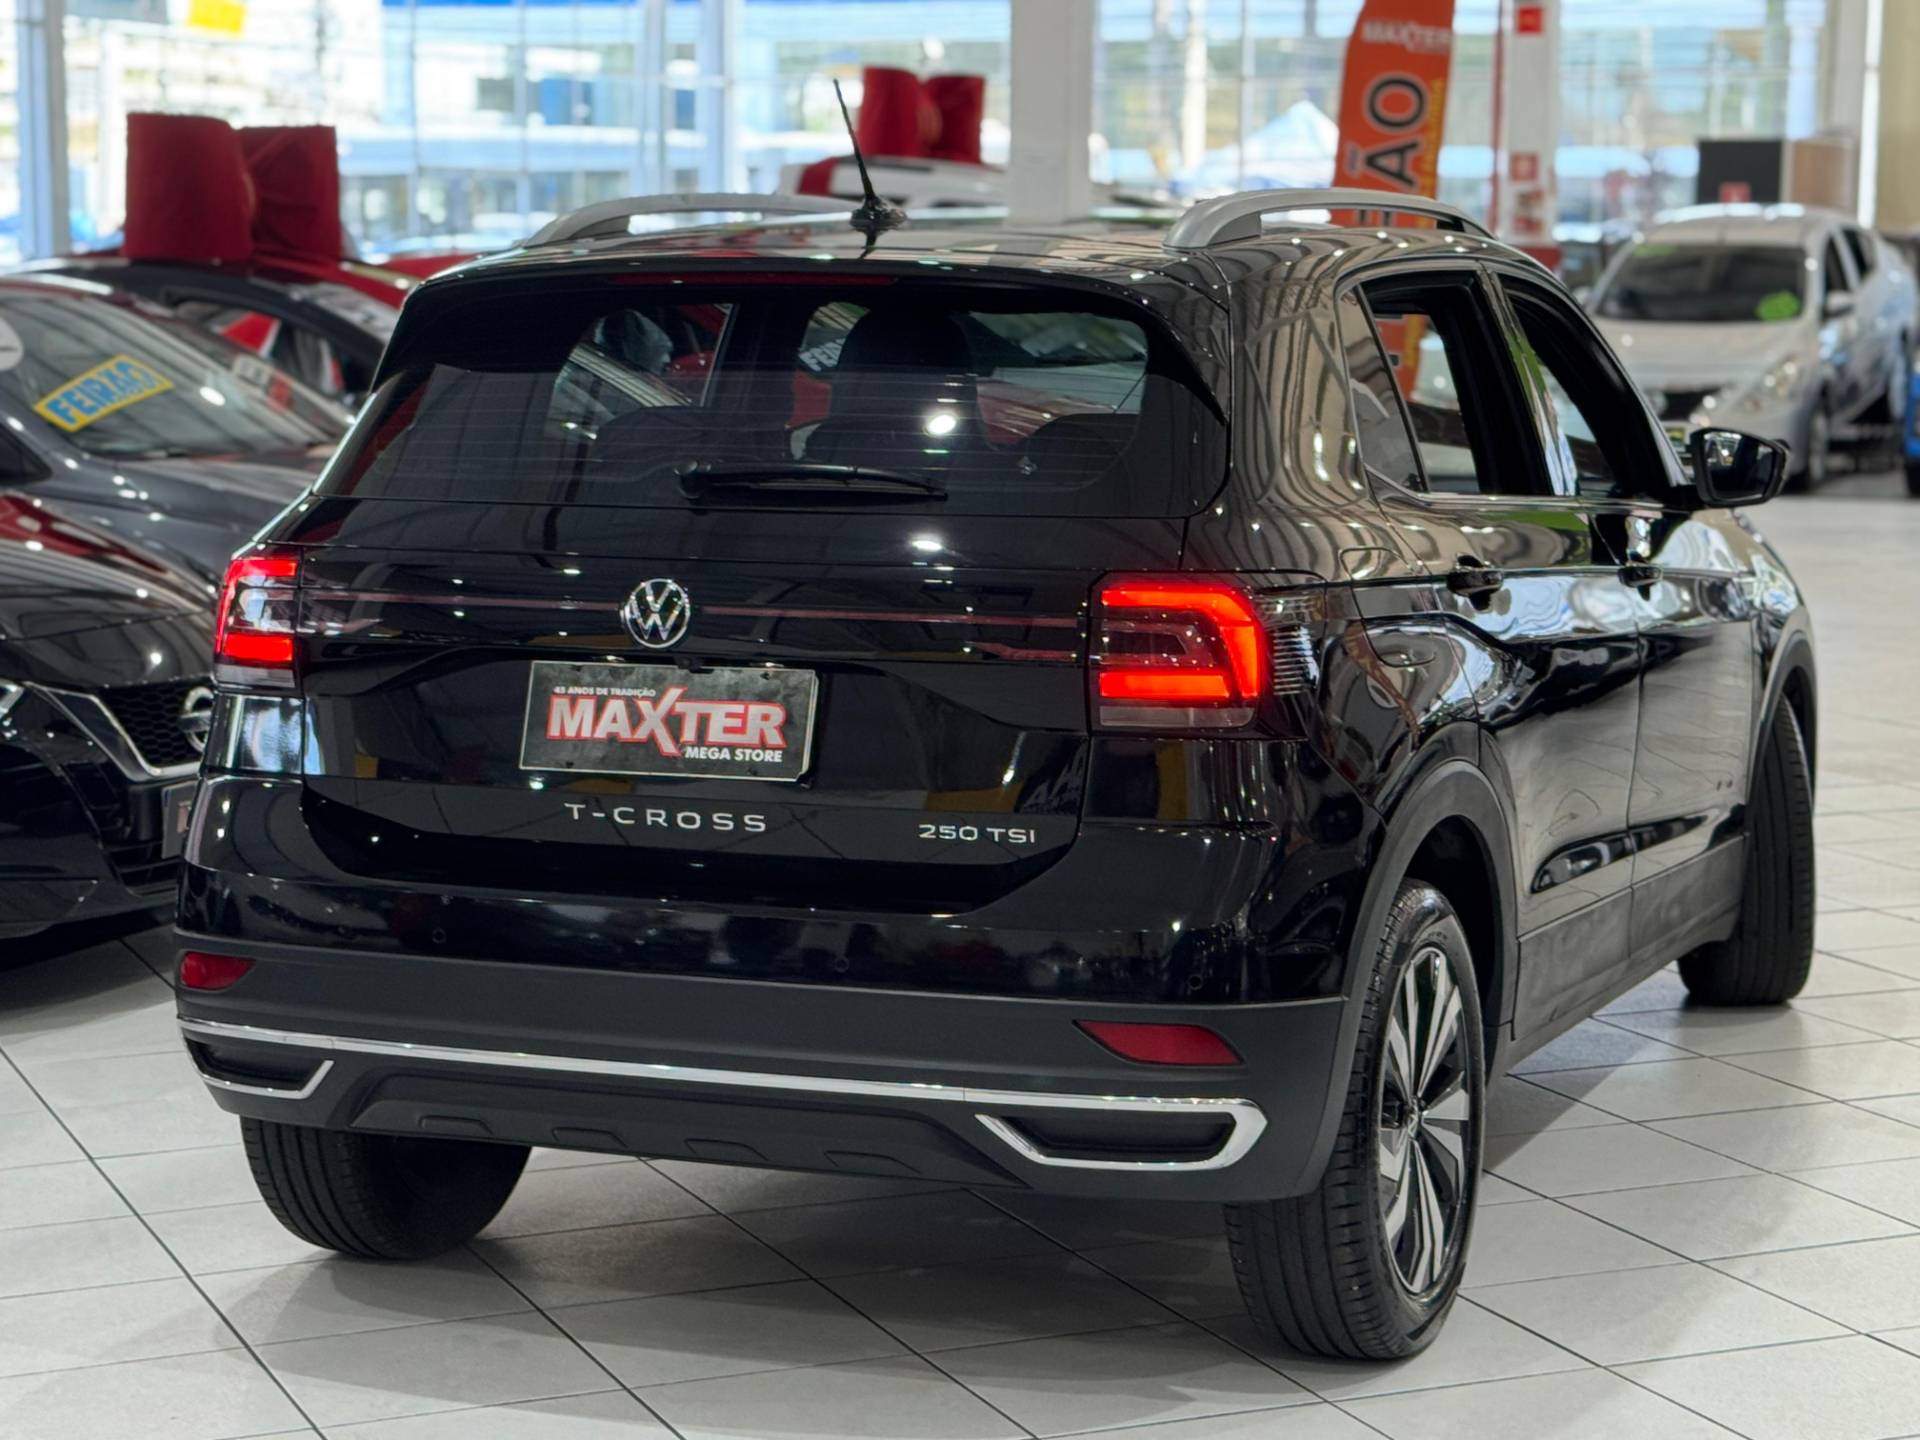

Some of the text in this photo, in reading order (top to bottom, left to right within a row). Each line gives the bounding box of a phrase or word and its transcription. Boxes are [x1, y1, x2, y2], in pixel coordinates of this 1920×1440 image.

[567, 686, 594, 695] ANOS
[596, 687, 608, 696] DE
[609, 686, 656, 697] TRADIÇÃO
[547, 687, 786, 756] MAXTER
[684, 746, 783, 762] MEGA STORE
[564, 803, 766, 832] T-CROSS
[919, 824, 1035, 843] 250 TSI
